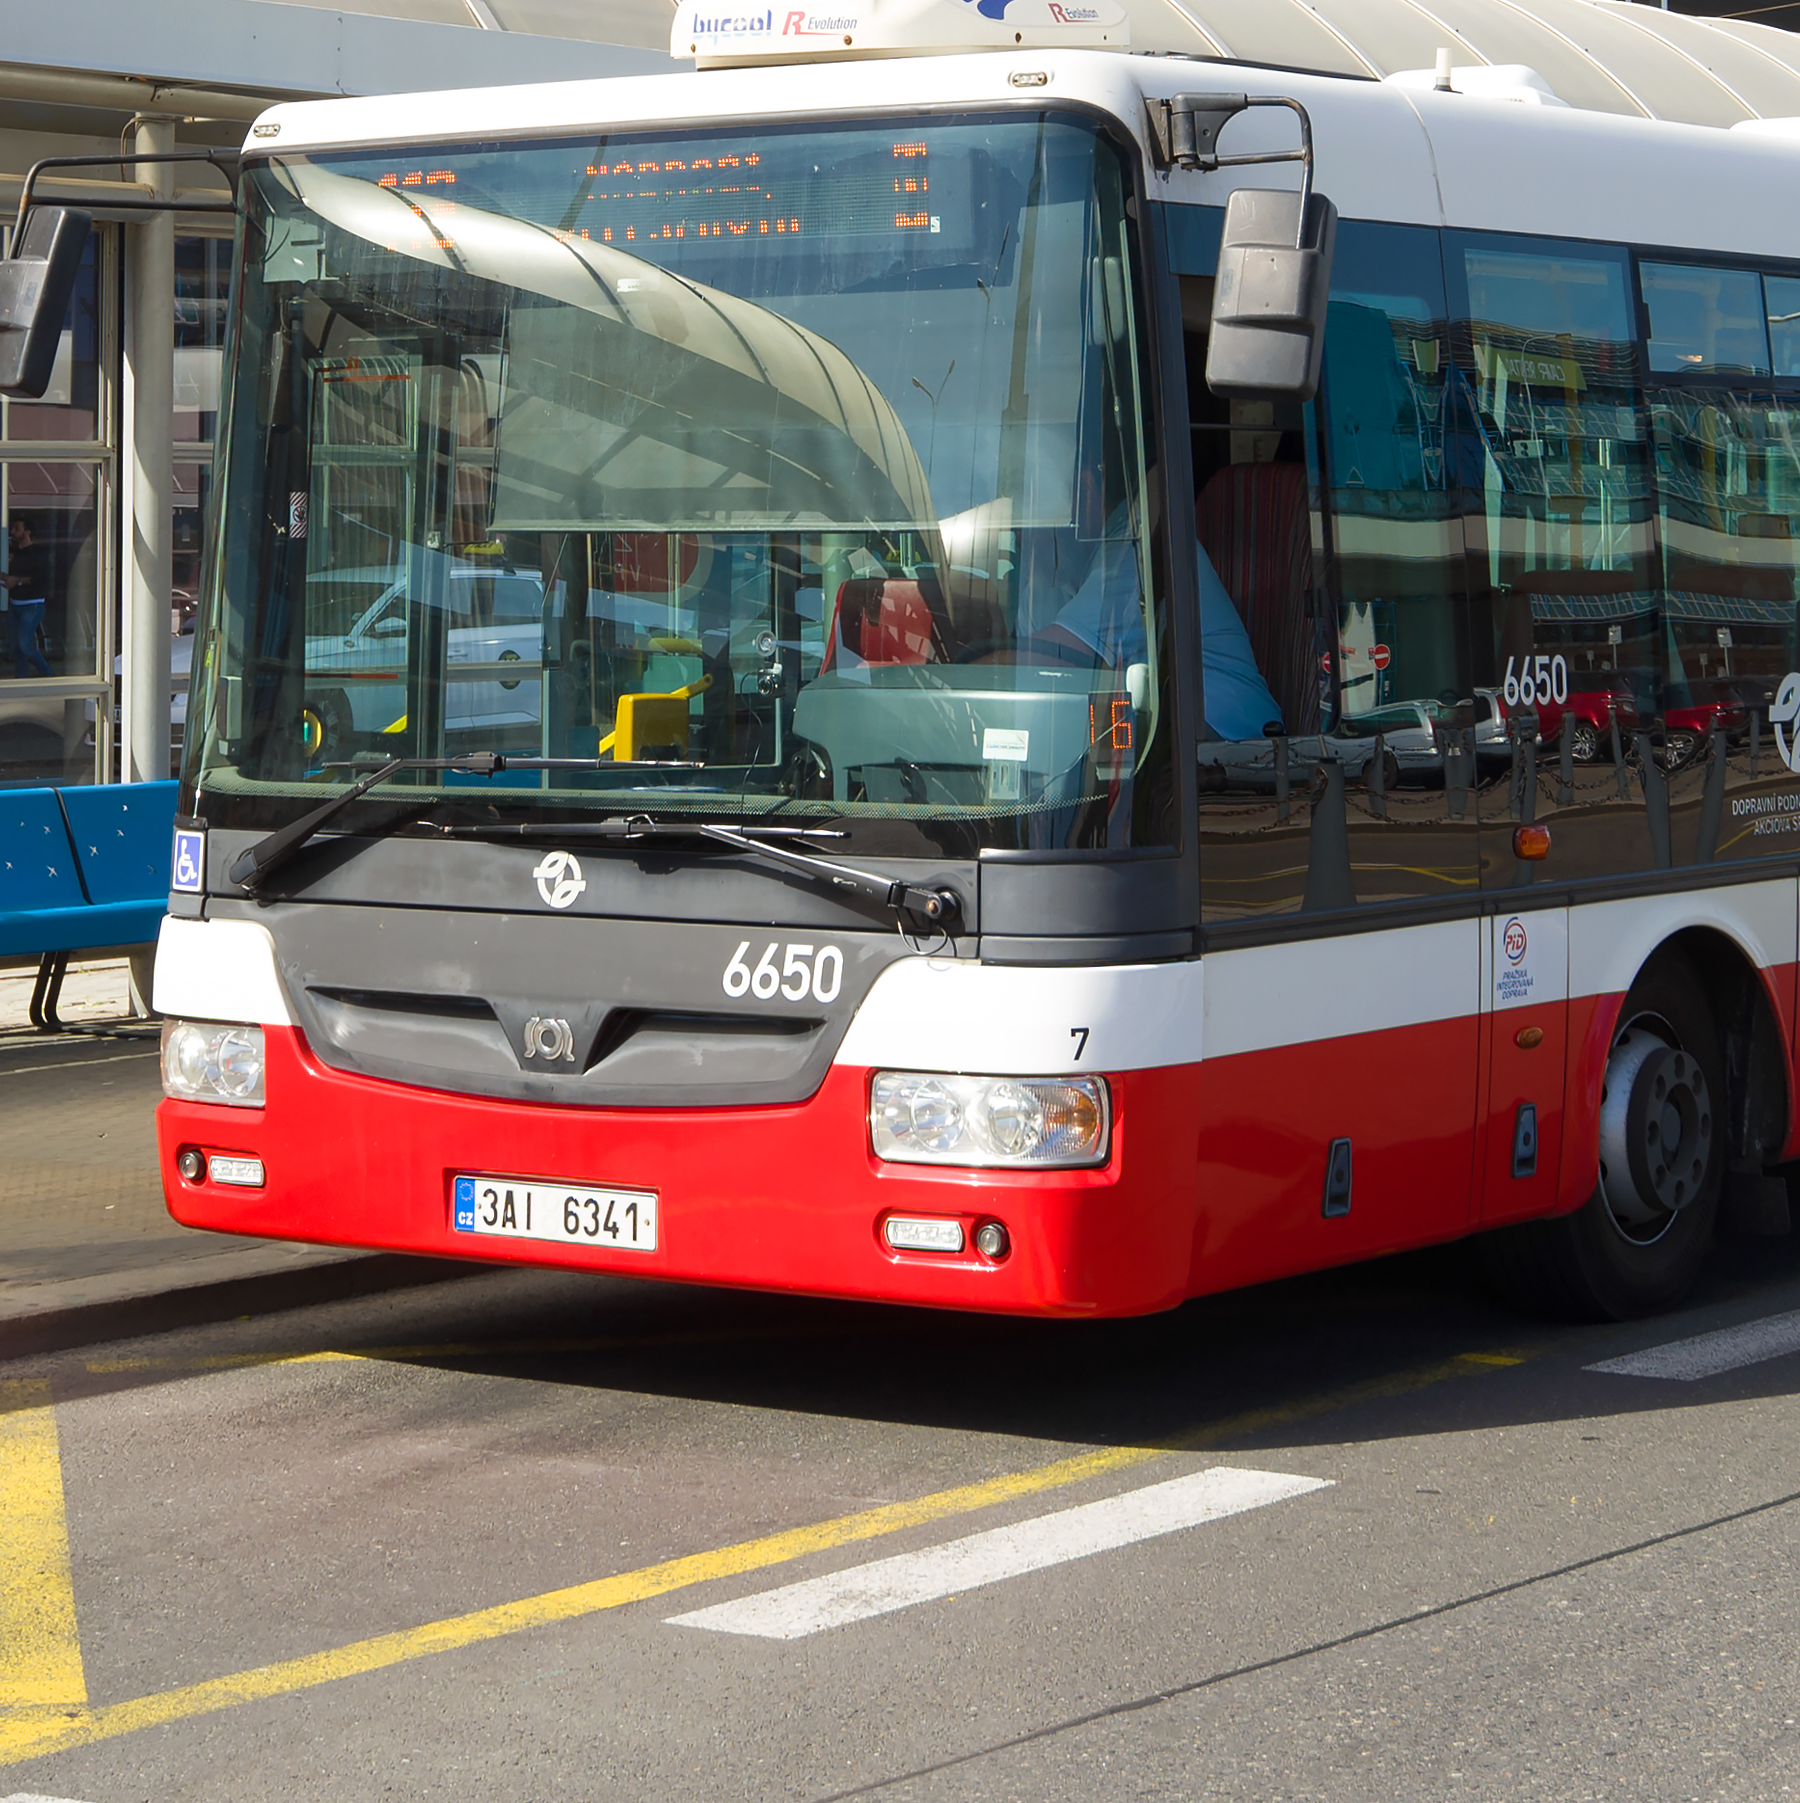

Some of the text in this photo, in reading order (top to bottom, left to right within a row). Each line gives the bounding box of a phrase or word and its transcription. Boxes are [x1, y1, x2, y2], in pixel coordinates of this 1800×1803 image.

[1503, 655, 1568, 707] 6650
[1731, 791, 1777, 816] DOPRAVNÍ
[721, 940, 844, 1005] 6650
[1069, 1026, 1090, 1061] 7
[457, 1183, 641, 1242] CZ 3AI 6341
